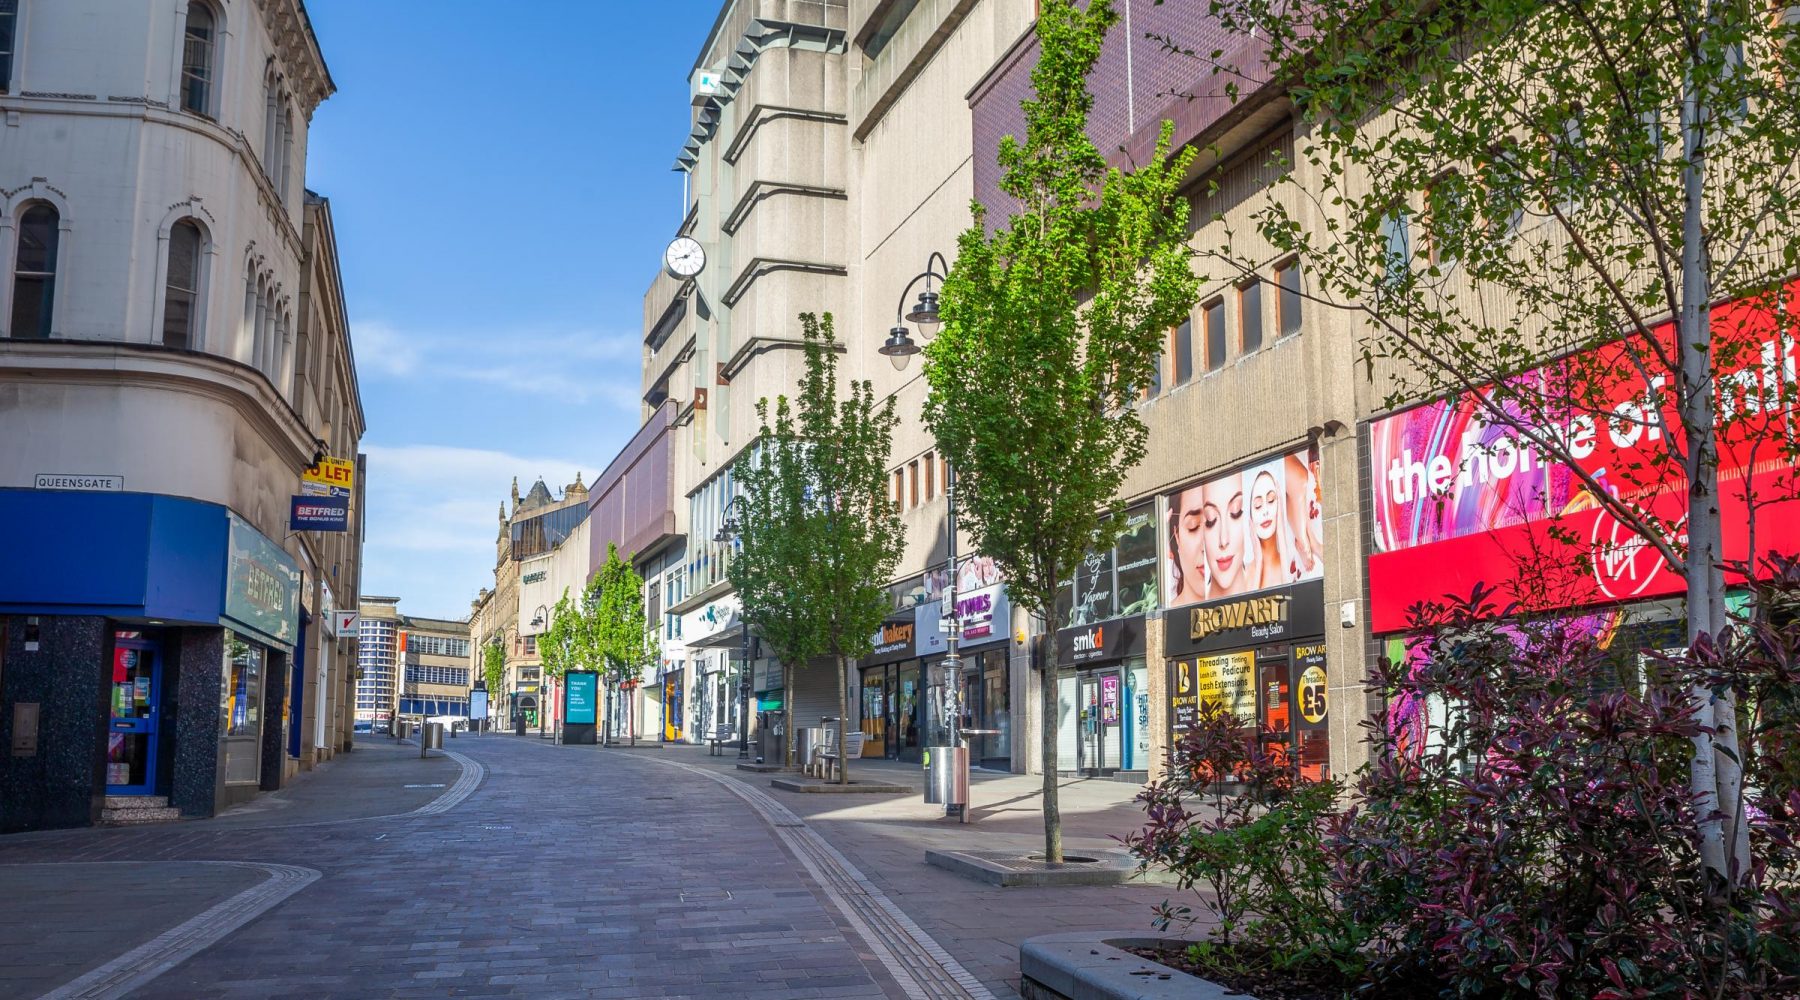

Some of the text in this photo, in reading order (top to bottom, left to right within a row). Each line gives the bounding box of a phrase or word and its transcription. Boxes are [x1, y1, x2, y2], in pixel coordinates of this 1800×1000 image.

[1388, 375, 1668, 505] the home of
[325, 465, 351, 482] LET
[38, 478, 112, 489] QUEENSGATE
[297, 507, 345, 516] BETFRED
[247, 563, 284, 611] BETFRED
[1091, 570, 1100, 591] of
[1251, 623, 1284, 638] Beauty Salon
[1073, 626, 1103, 652] smkd
[1296, 646, 1316, 659] BROW
[1199, 656, 1248, 668] Threading Tinting
[1222, 665, 1251, 676] Pedicure
[1200, 677, 1248, 691] Lash Extensions
[1172, 696, 1198, 707] BROW ART
[1221, 690, 1235, 700] Body
[1235, 689, 1255, 698] Waxing
[1303, 685, 1327, 717] £5
